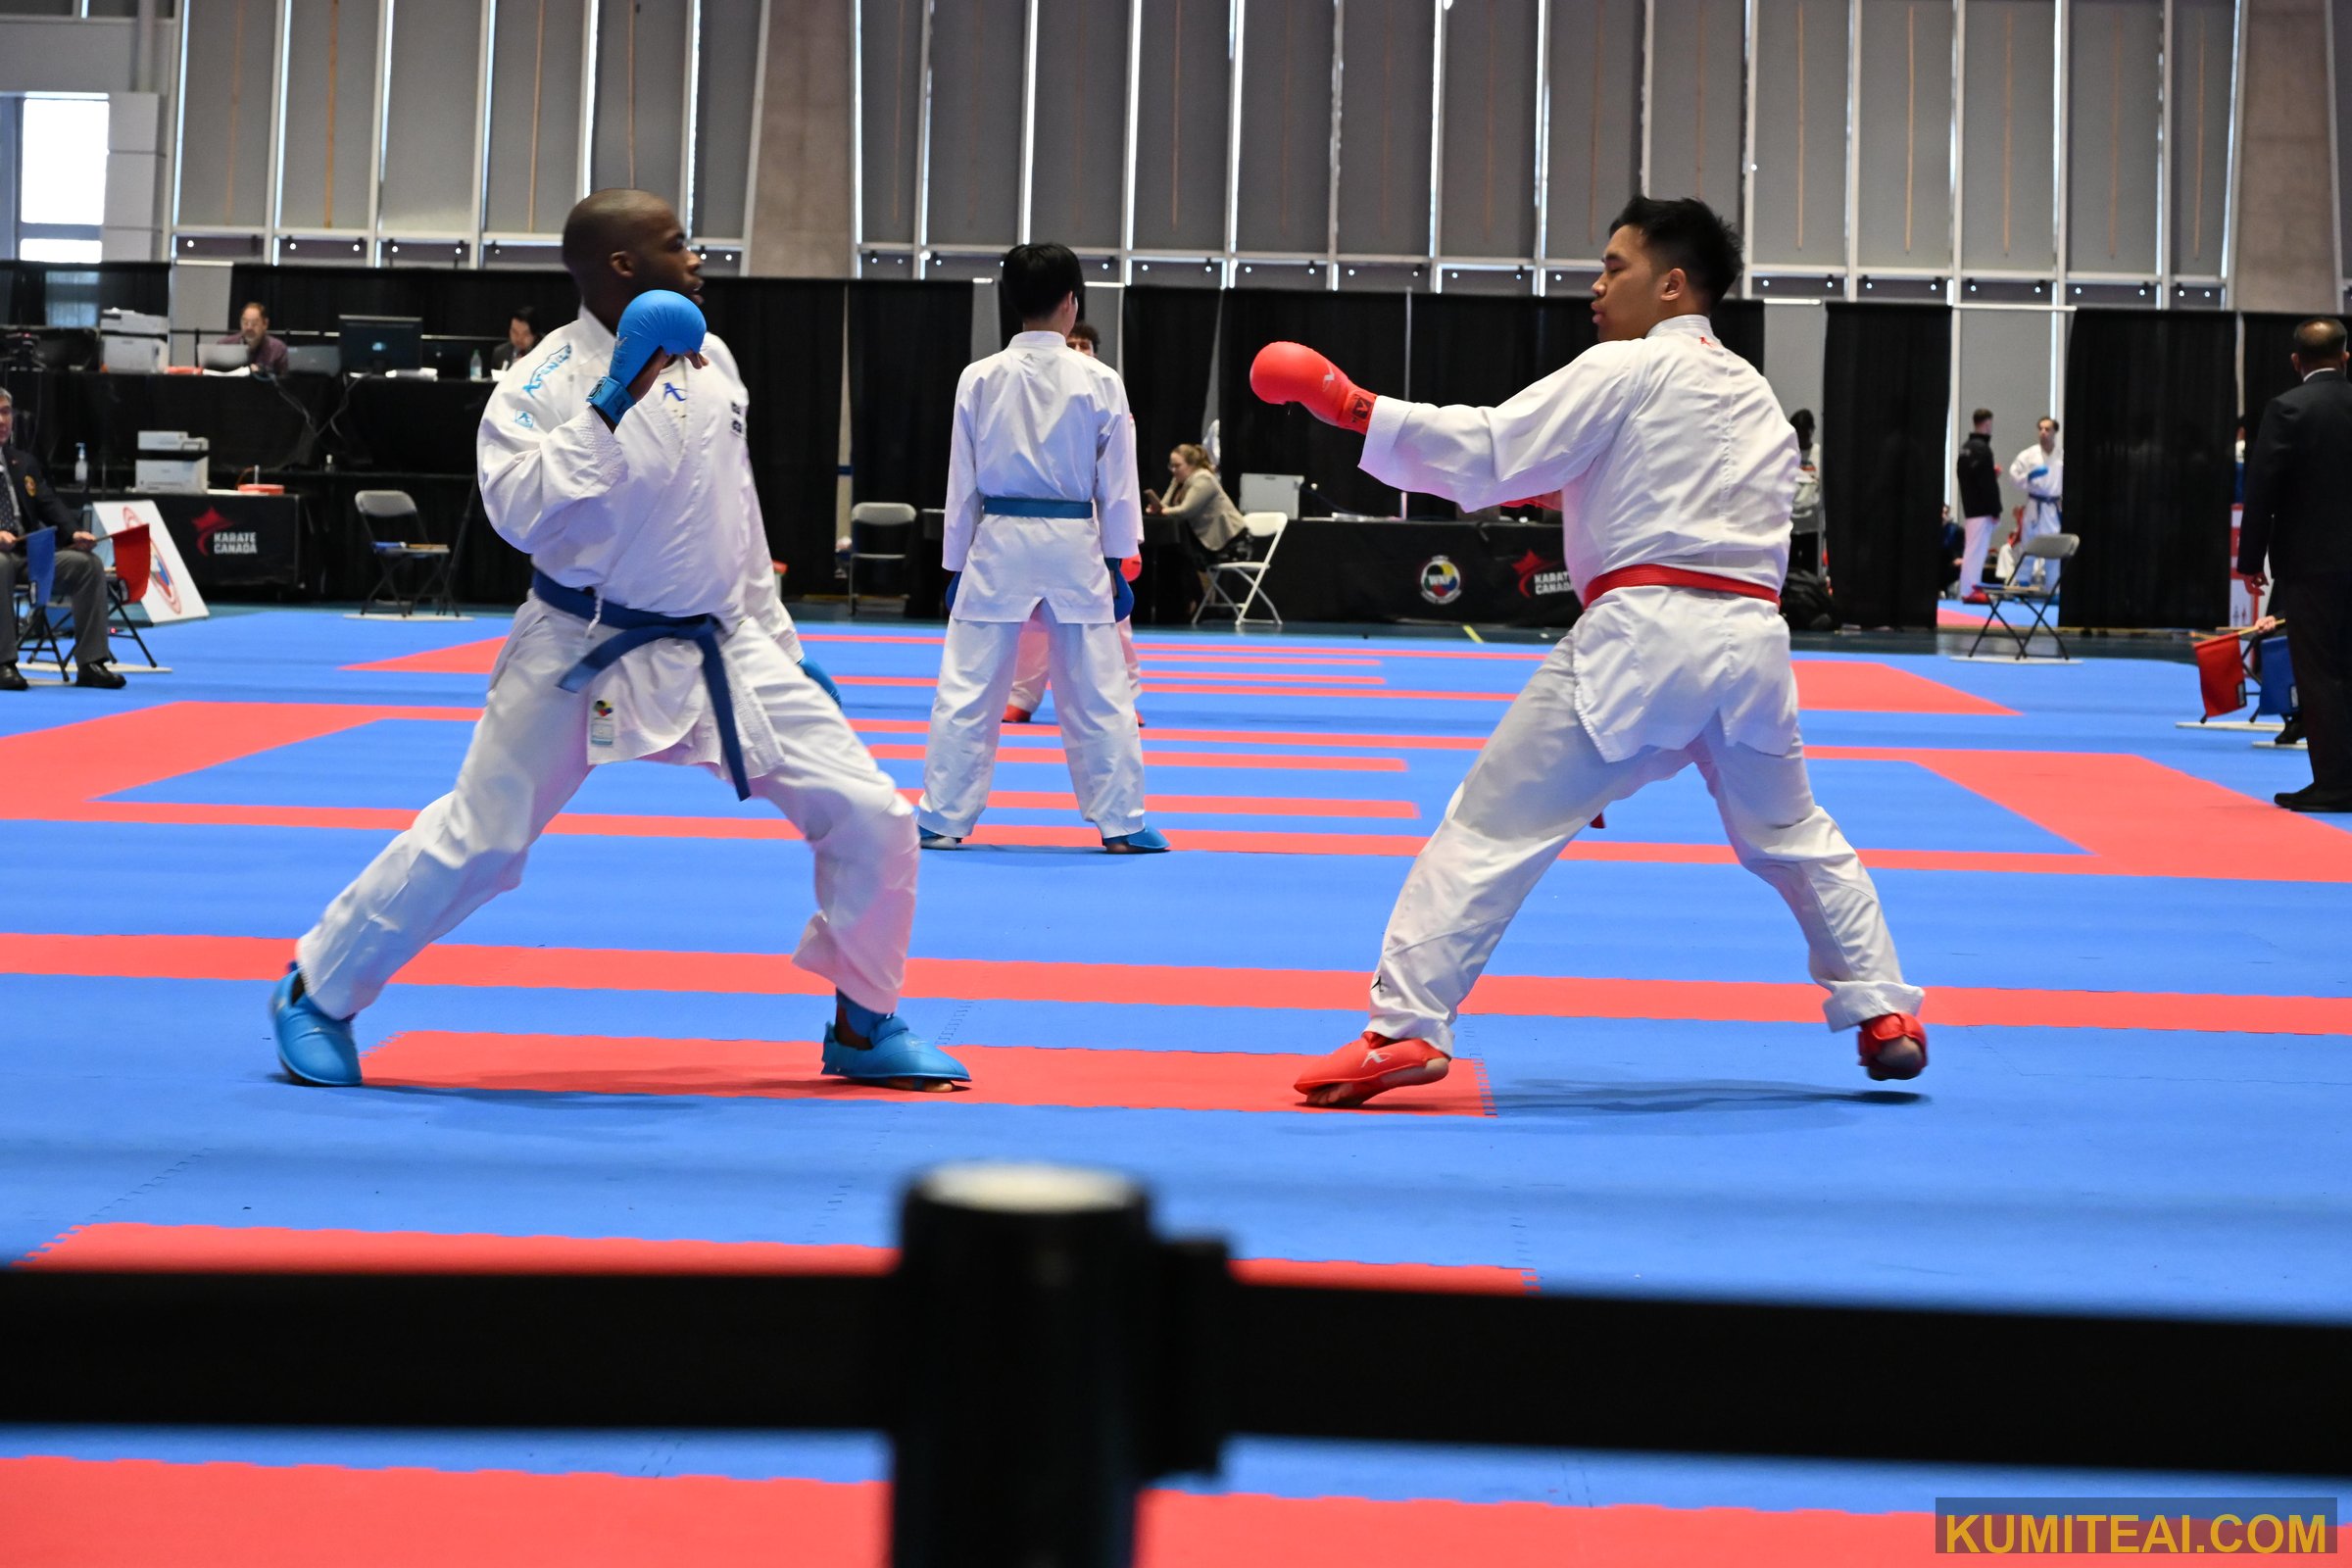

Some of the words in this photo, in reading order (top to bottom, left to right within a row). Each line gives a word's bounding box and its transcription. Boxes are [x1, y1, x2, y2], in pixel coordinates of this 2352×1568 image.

[214, 531, 257, 543] KARATE
[214, 542, 259, 555] CANADA
[1534, 570, 1568, 583] KARAT
